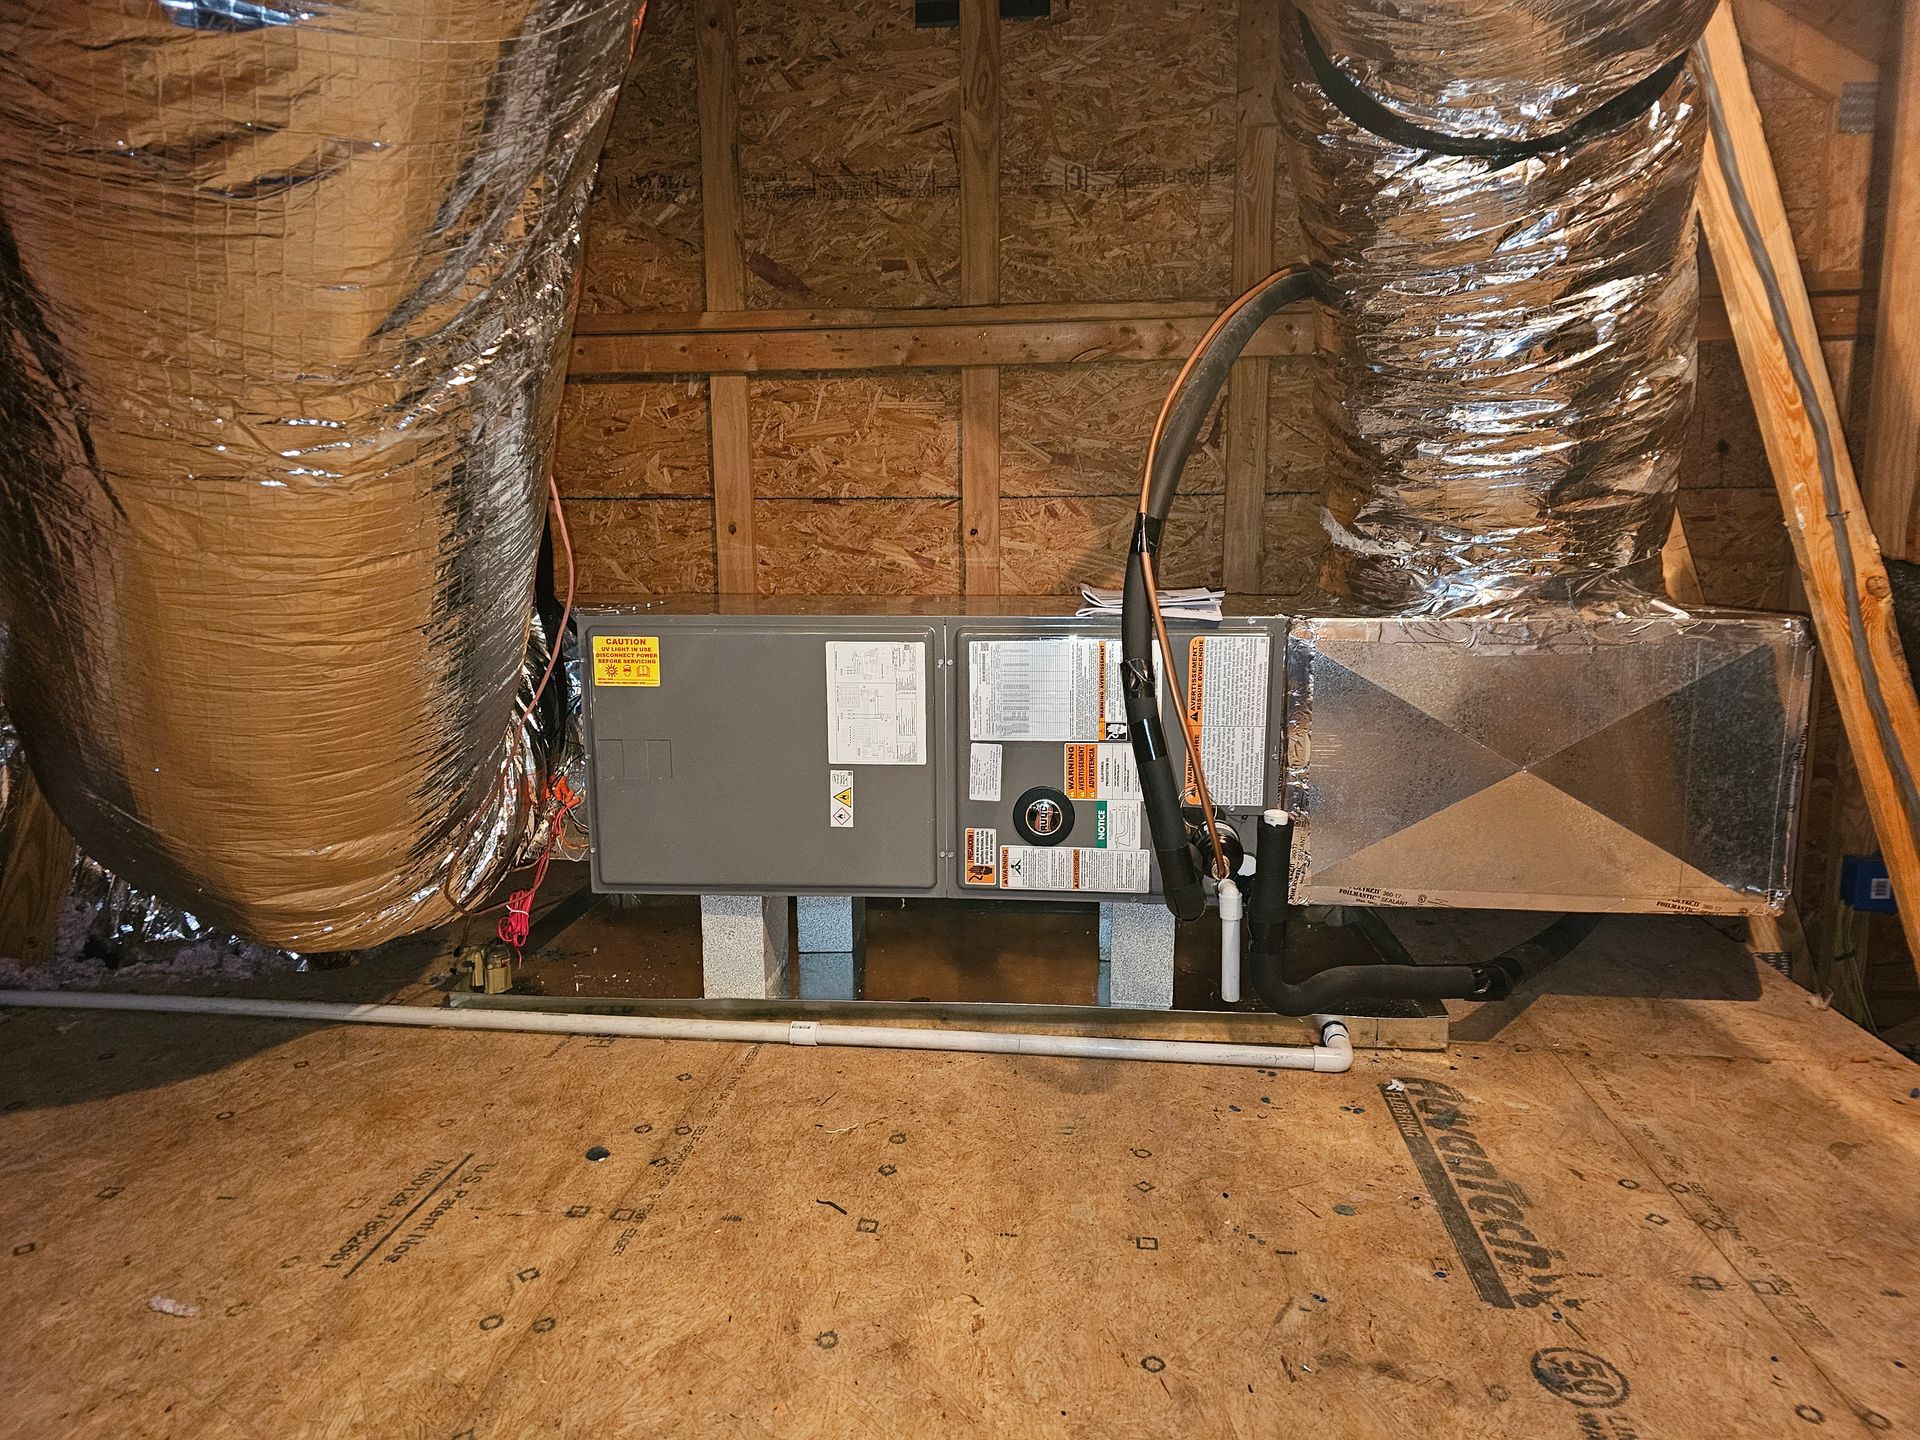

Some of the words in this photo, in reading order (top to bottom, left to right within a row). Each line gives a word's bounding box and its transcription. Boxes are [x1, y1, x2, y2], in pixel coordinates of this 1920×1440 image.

[1190, 646, 1198, 712] AVERTISSEMENT
[1040, 805, 1048, 831] RUUD
[1097, 810, 1105, 841] NOTICE
[1380, 896, 1409, 906] SEALANT
[414, 1188, 470, 1232] Patent
